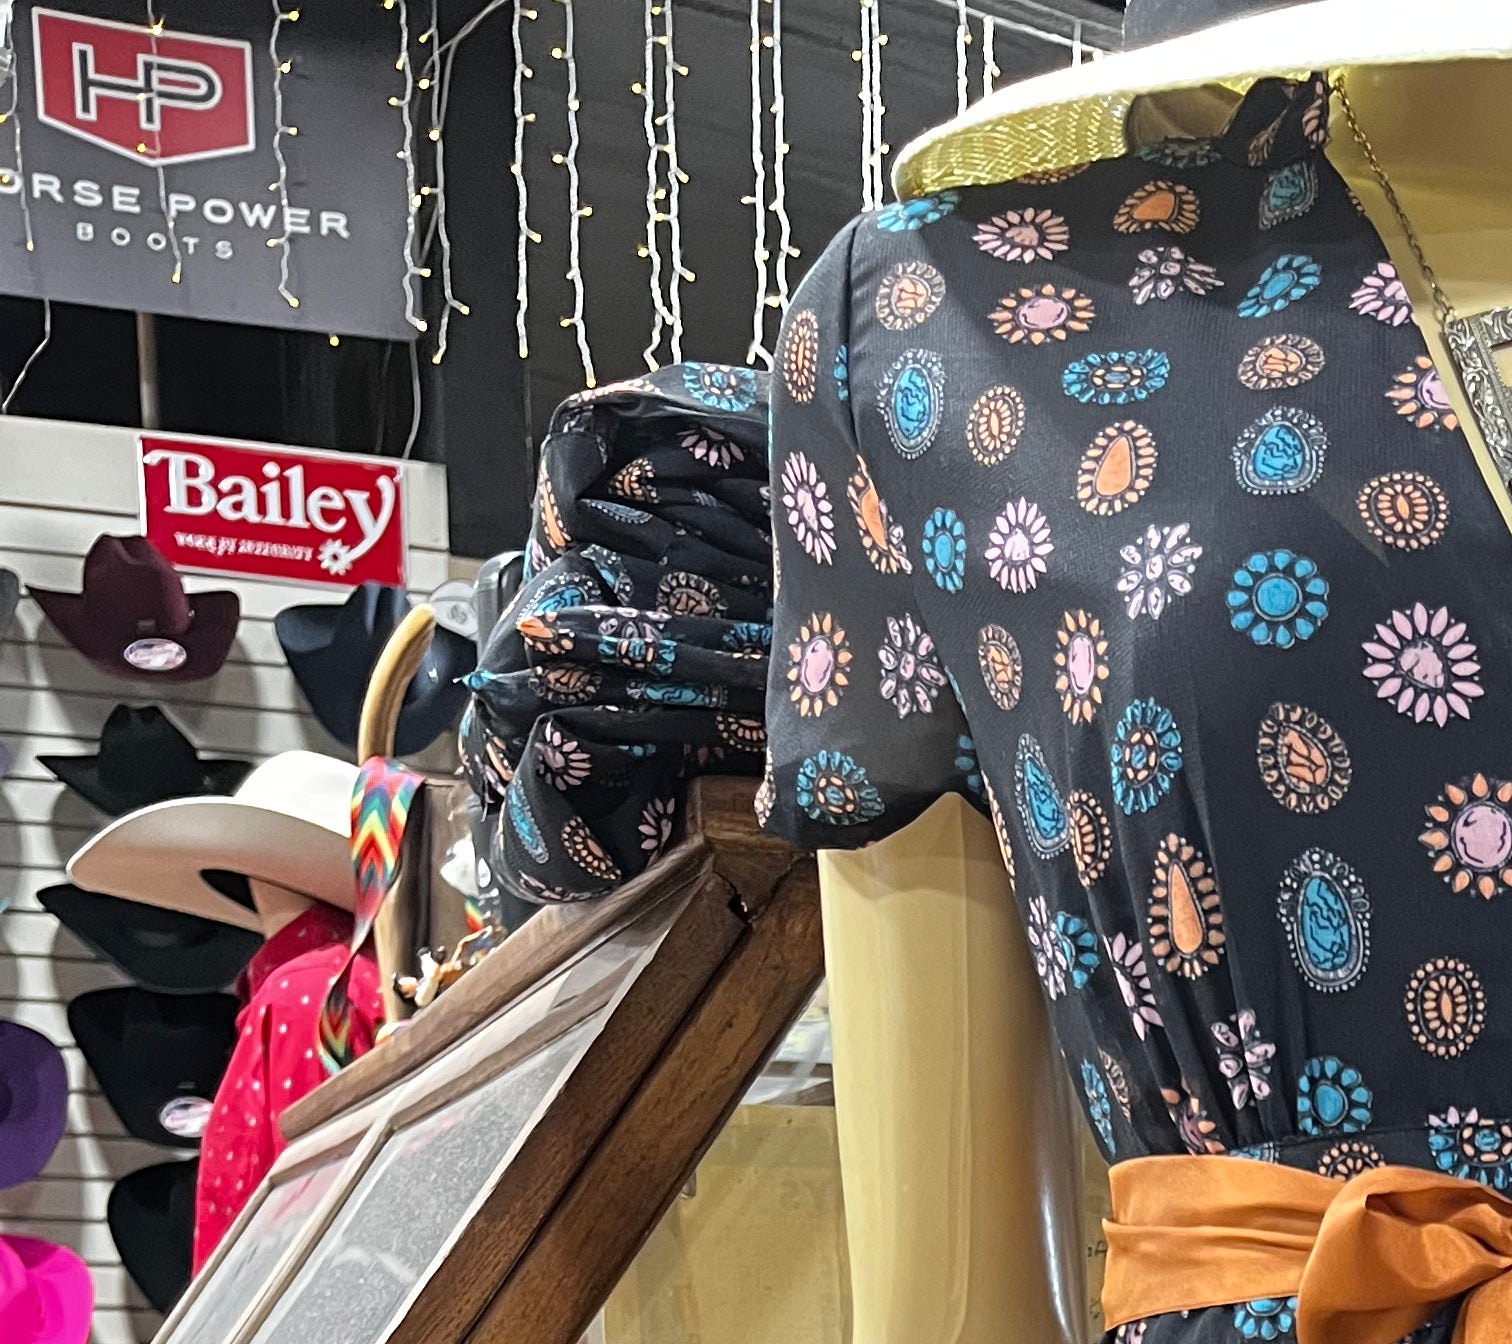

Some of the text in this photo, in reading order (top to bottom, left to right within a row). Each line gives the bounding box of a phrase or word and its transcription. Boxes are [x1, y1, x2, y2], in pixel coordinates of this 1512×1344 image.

[72, 42, 222, 131] HP
[76, 222, 233, 260] BOOTS
[168, 193, 349, 239] POWER
[143, 449, 396, 564] Bailey
